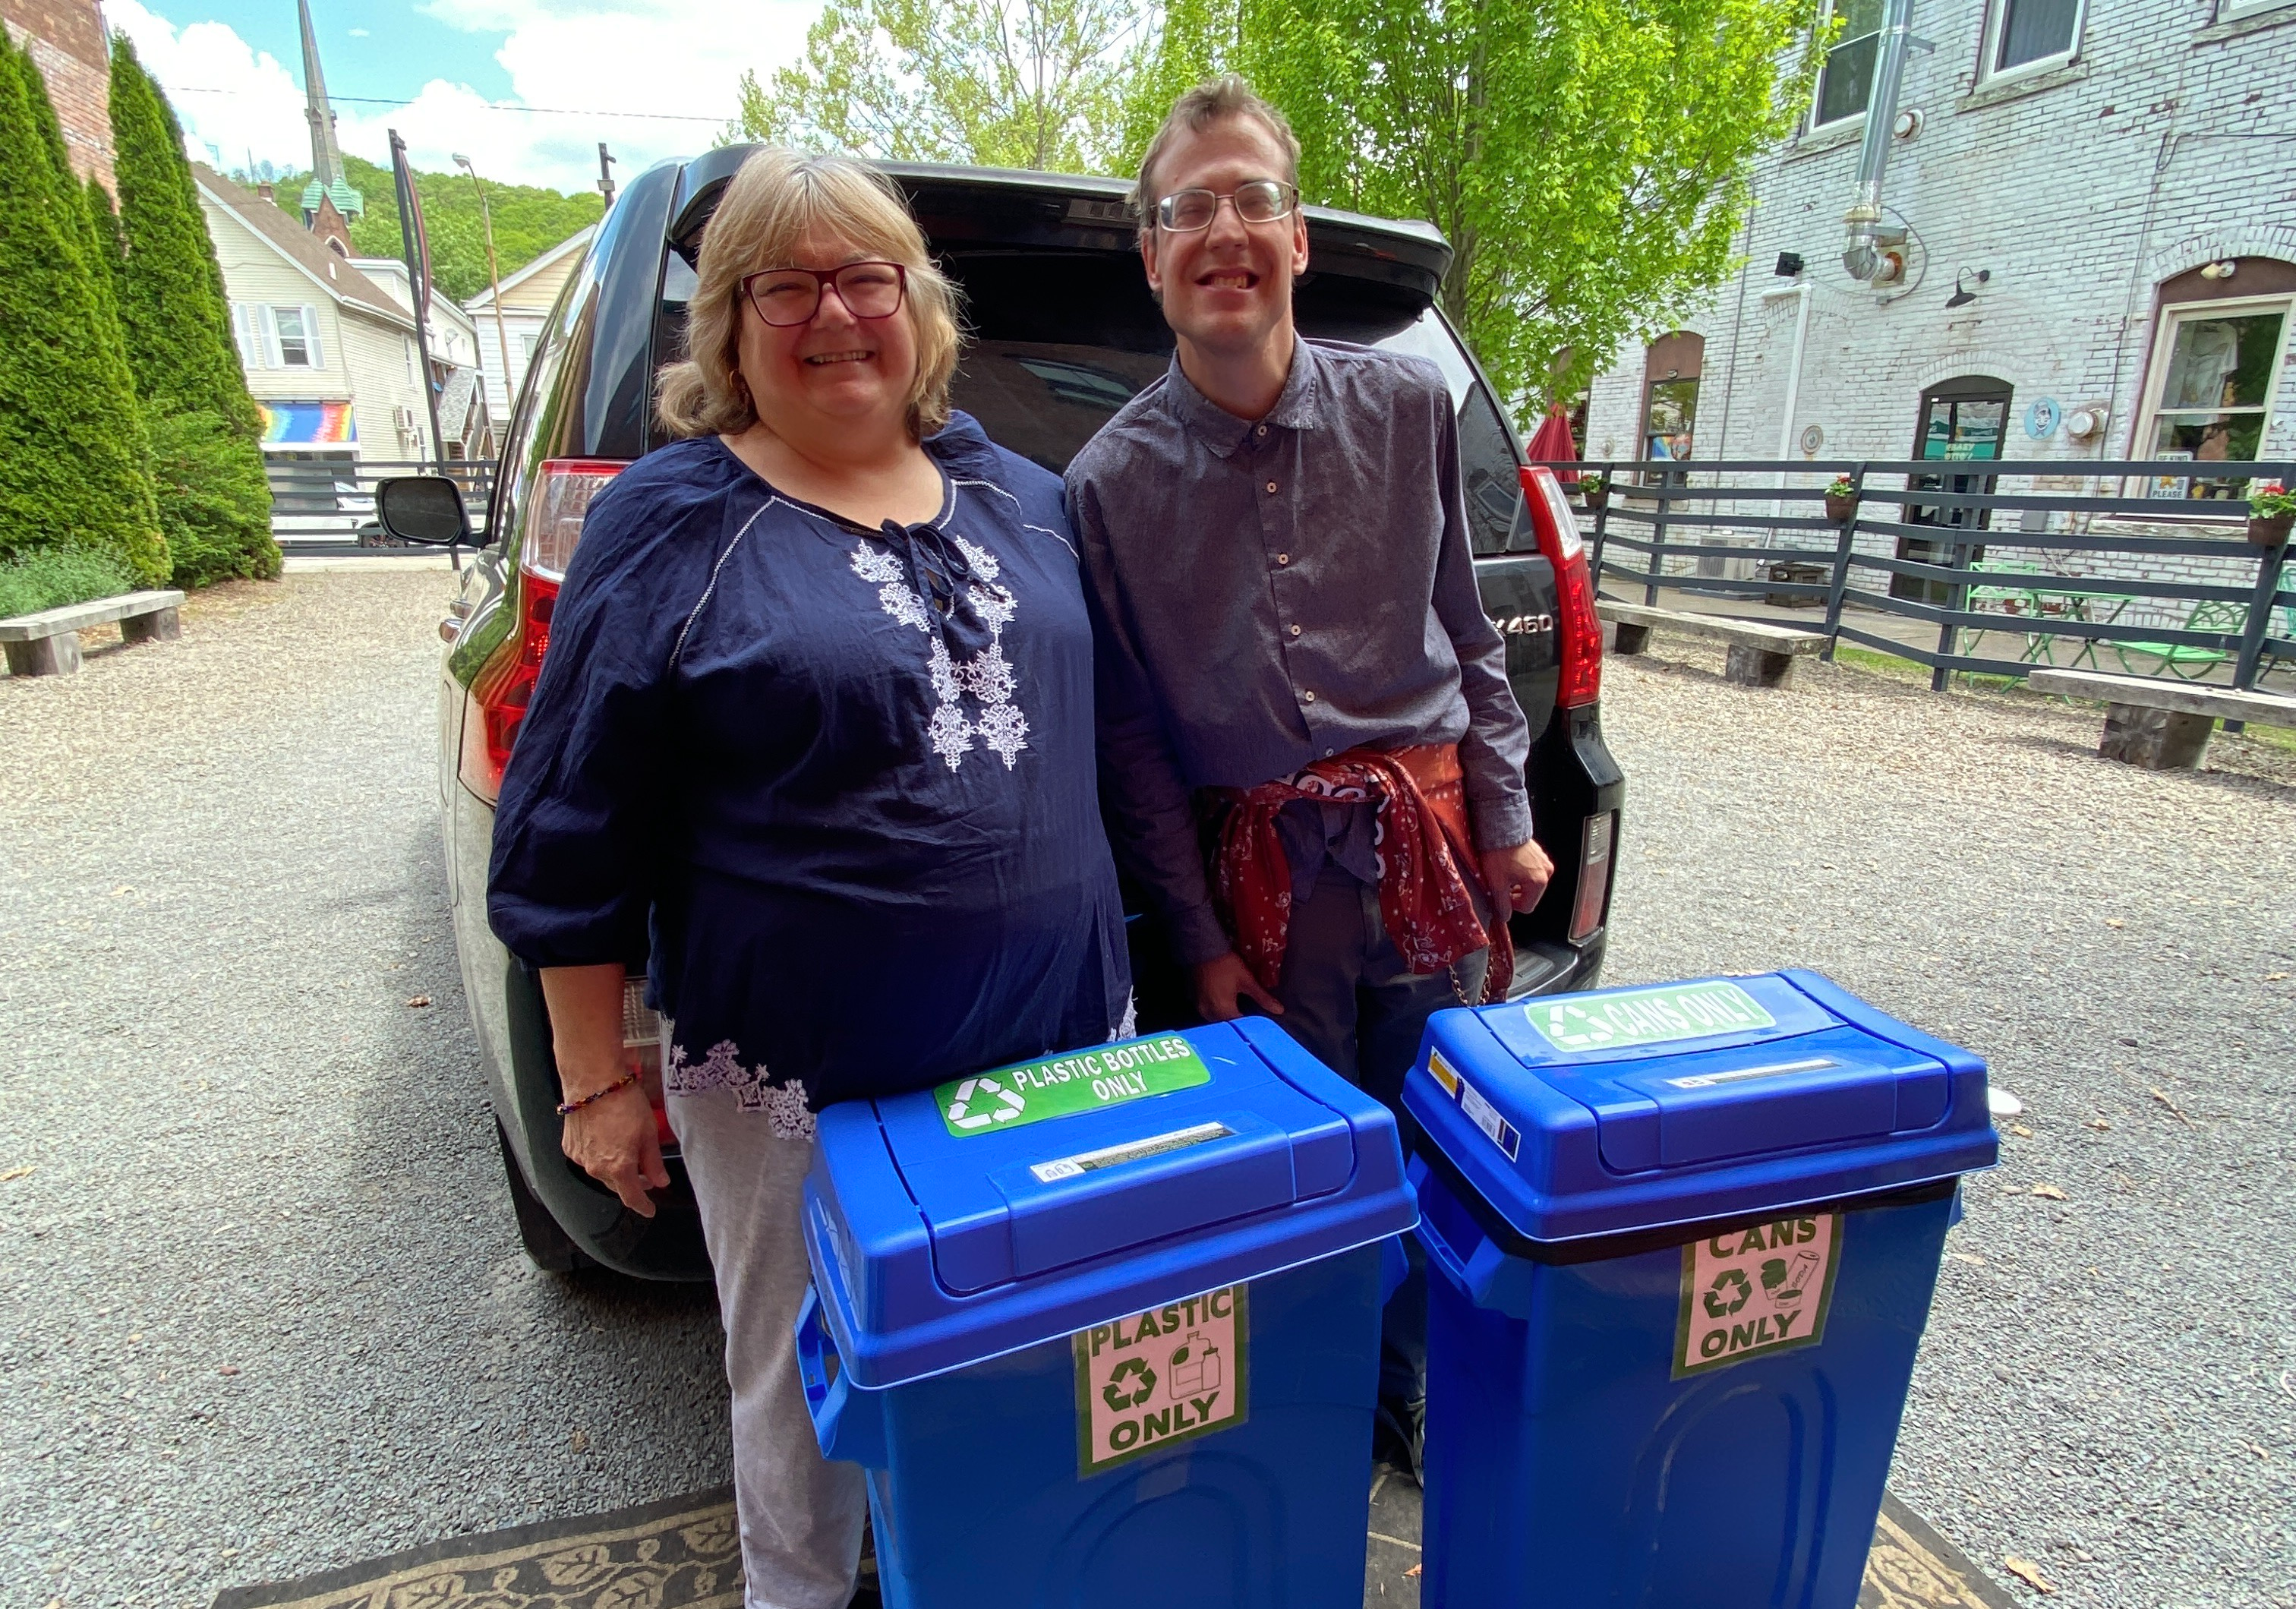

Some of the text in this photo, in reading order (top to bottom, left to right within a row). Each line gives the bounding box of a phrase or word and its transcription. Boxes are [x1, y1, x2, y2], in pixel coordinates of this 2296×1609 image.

[2152, 490, 2183, 498] PLEASE
[1603, 989, 1761, 1036] CANS ONLY
[1011, 1037, 1191, 1091] PLASTIC BOTTLES
[1092, 1071, 1149, 1102] ONLY
[1709, 1216, 1817, 1259] CANS
[1091, 1288, 1232, 1358] PLASTIC
[1700, 1309, 1802, 1358] ONLY
[1109, 1391, 1221, 1451] ONLY
